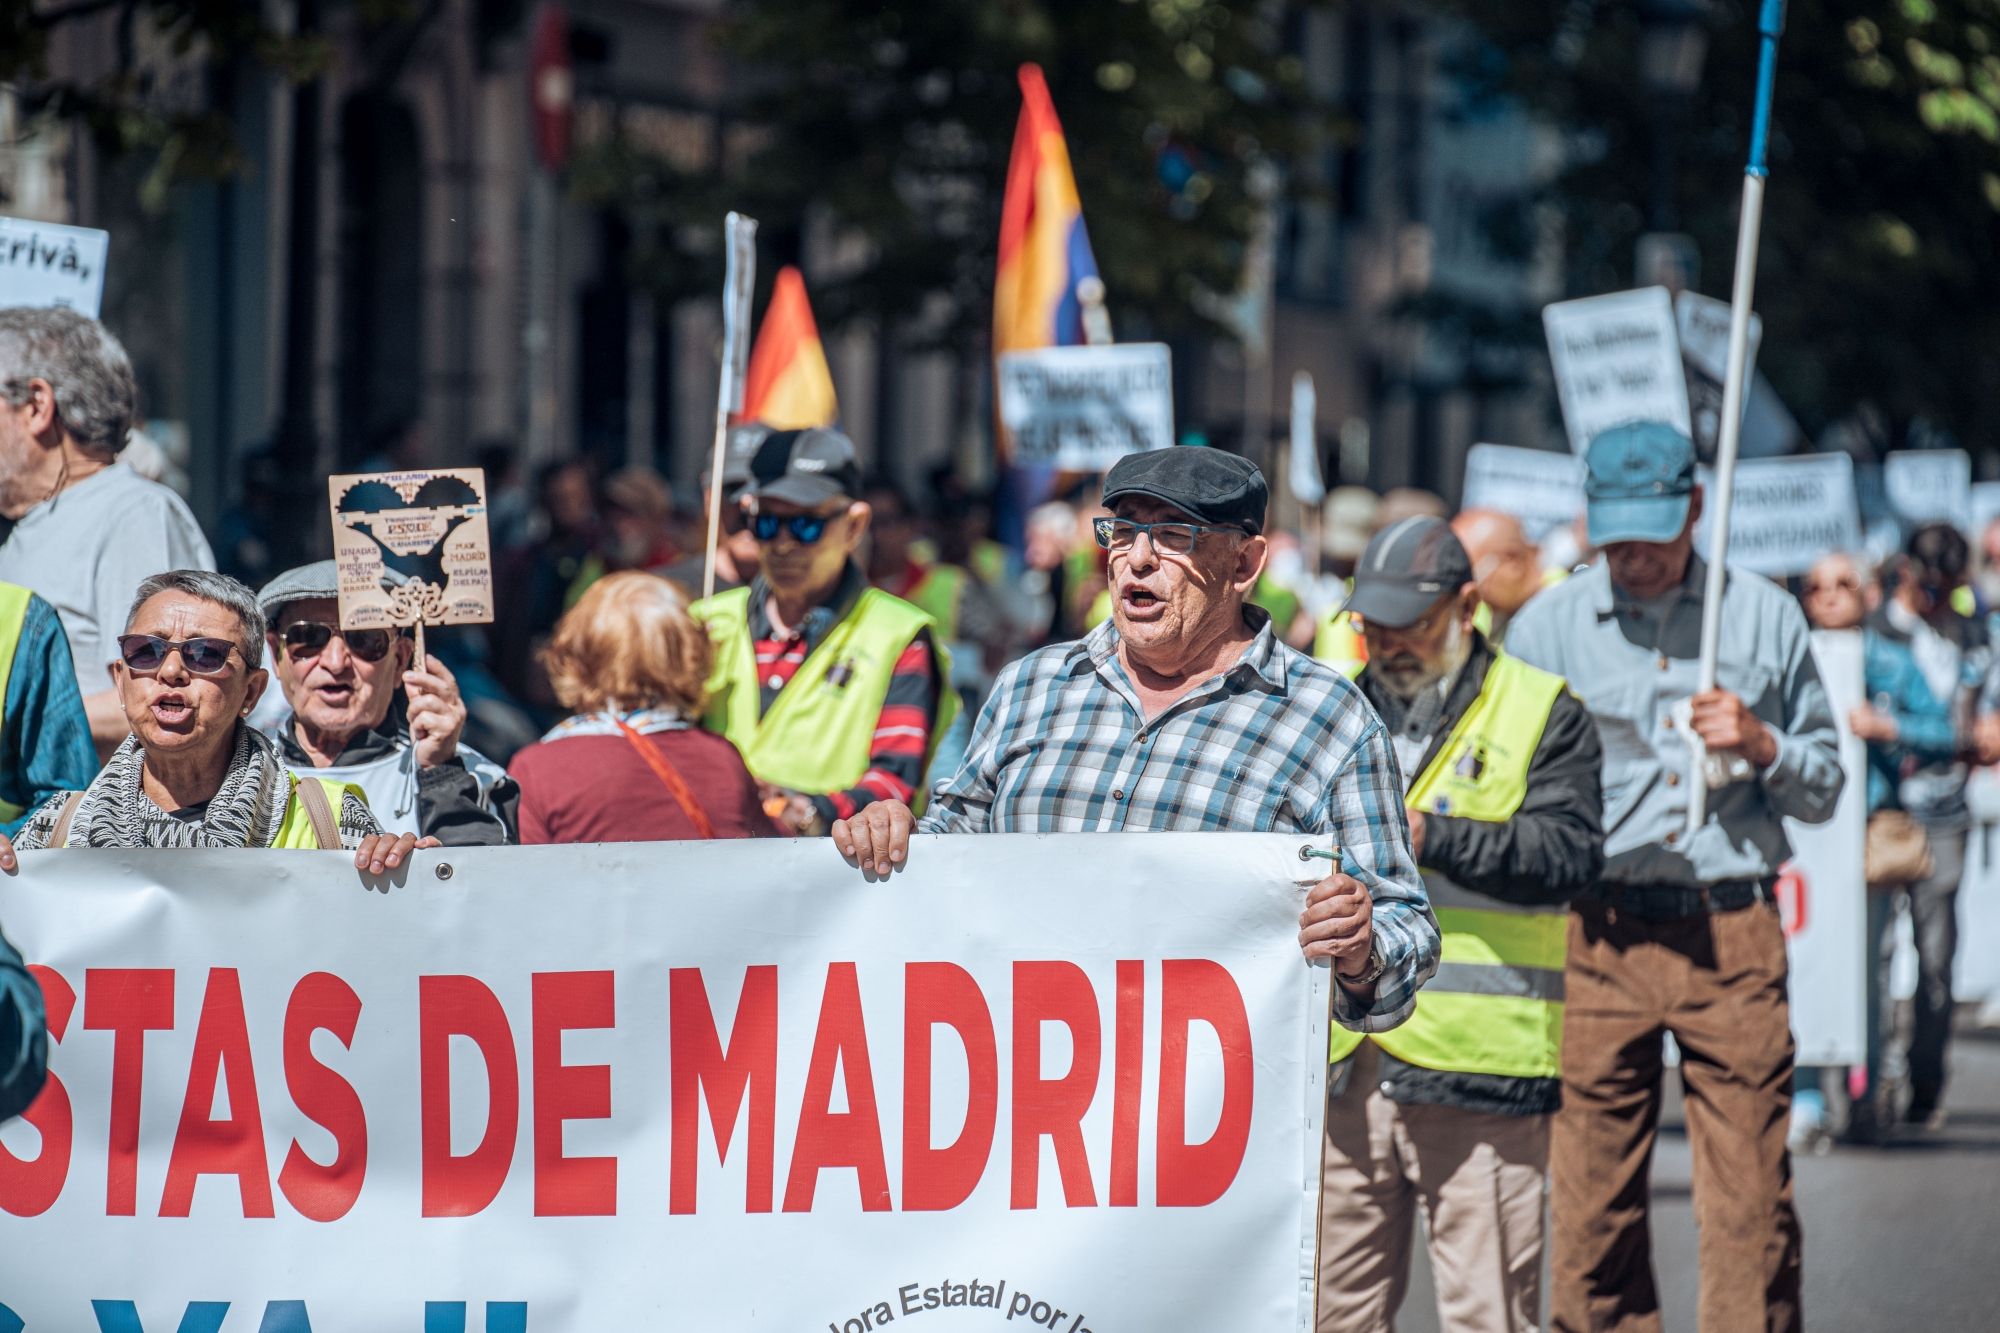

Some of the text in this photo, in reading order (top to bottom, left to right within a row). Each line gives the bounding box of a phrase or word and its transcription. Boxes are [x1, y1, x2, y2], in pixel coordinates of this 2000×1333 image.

[1730, 519, 1845, 550] ARANTIZADAS
[419, 969, 618, 1218] DE
[668, 958, 1254, 1216] MADRID
[898, 1278, 1006, 1316] Estatal
[1006, 1291, 1069, 1330] por
